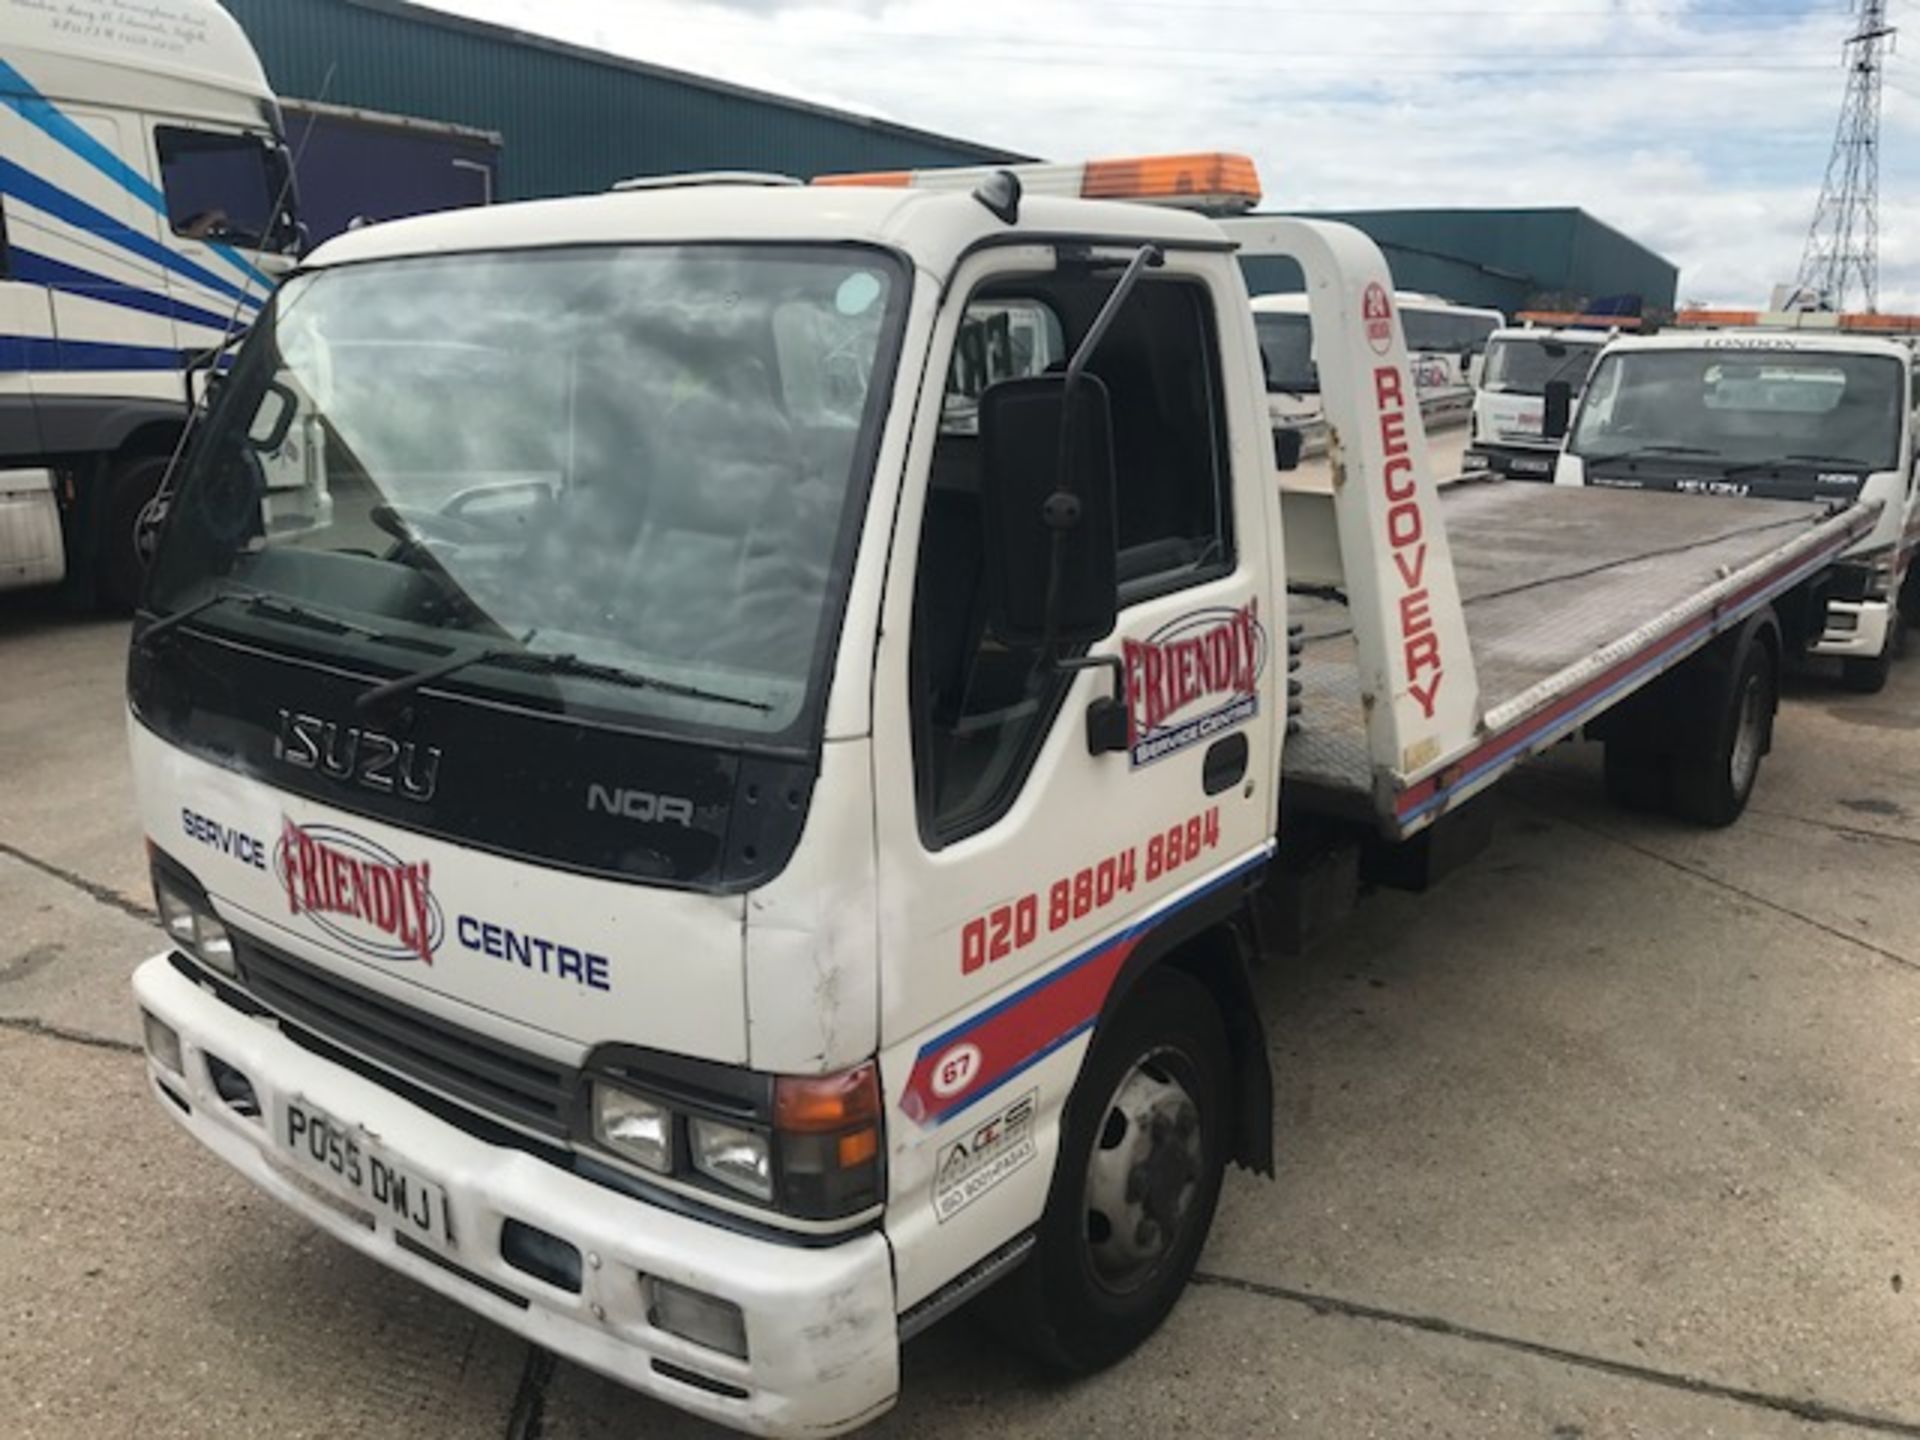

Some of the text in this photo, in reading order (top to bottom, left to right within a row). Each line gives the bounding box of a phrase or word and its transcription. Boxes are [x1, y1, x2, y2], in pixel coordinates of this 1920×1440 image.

[1703, 338, 1799, 350] LONDON
[1374, 366, 1443, 720] RECOVERY
[1121, 595, 1258, 752] FRIENDLY
[273, 708, 442, 803] ISUZU
[587, 783, 693, 828] NQR
[181, 806, 611, 992] SERVICE FRIENDLY CENTRE
[961, 806, 1219, 976] 020 8804 8884
[942, 1053, 970, 1085] 67
[368, 1153, 431, 1232] DWJ
